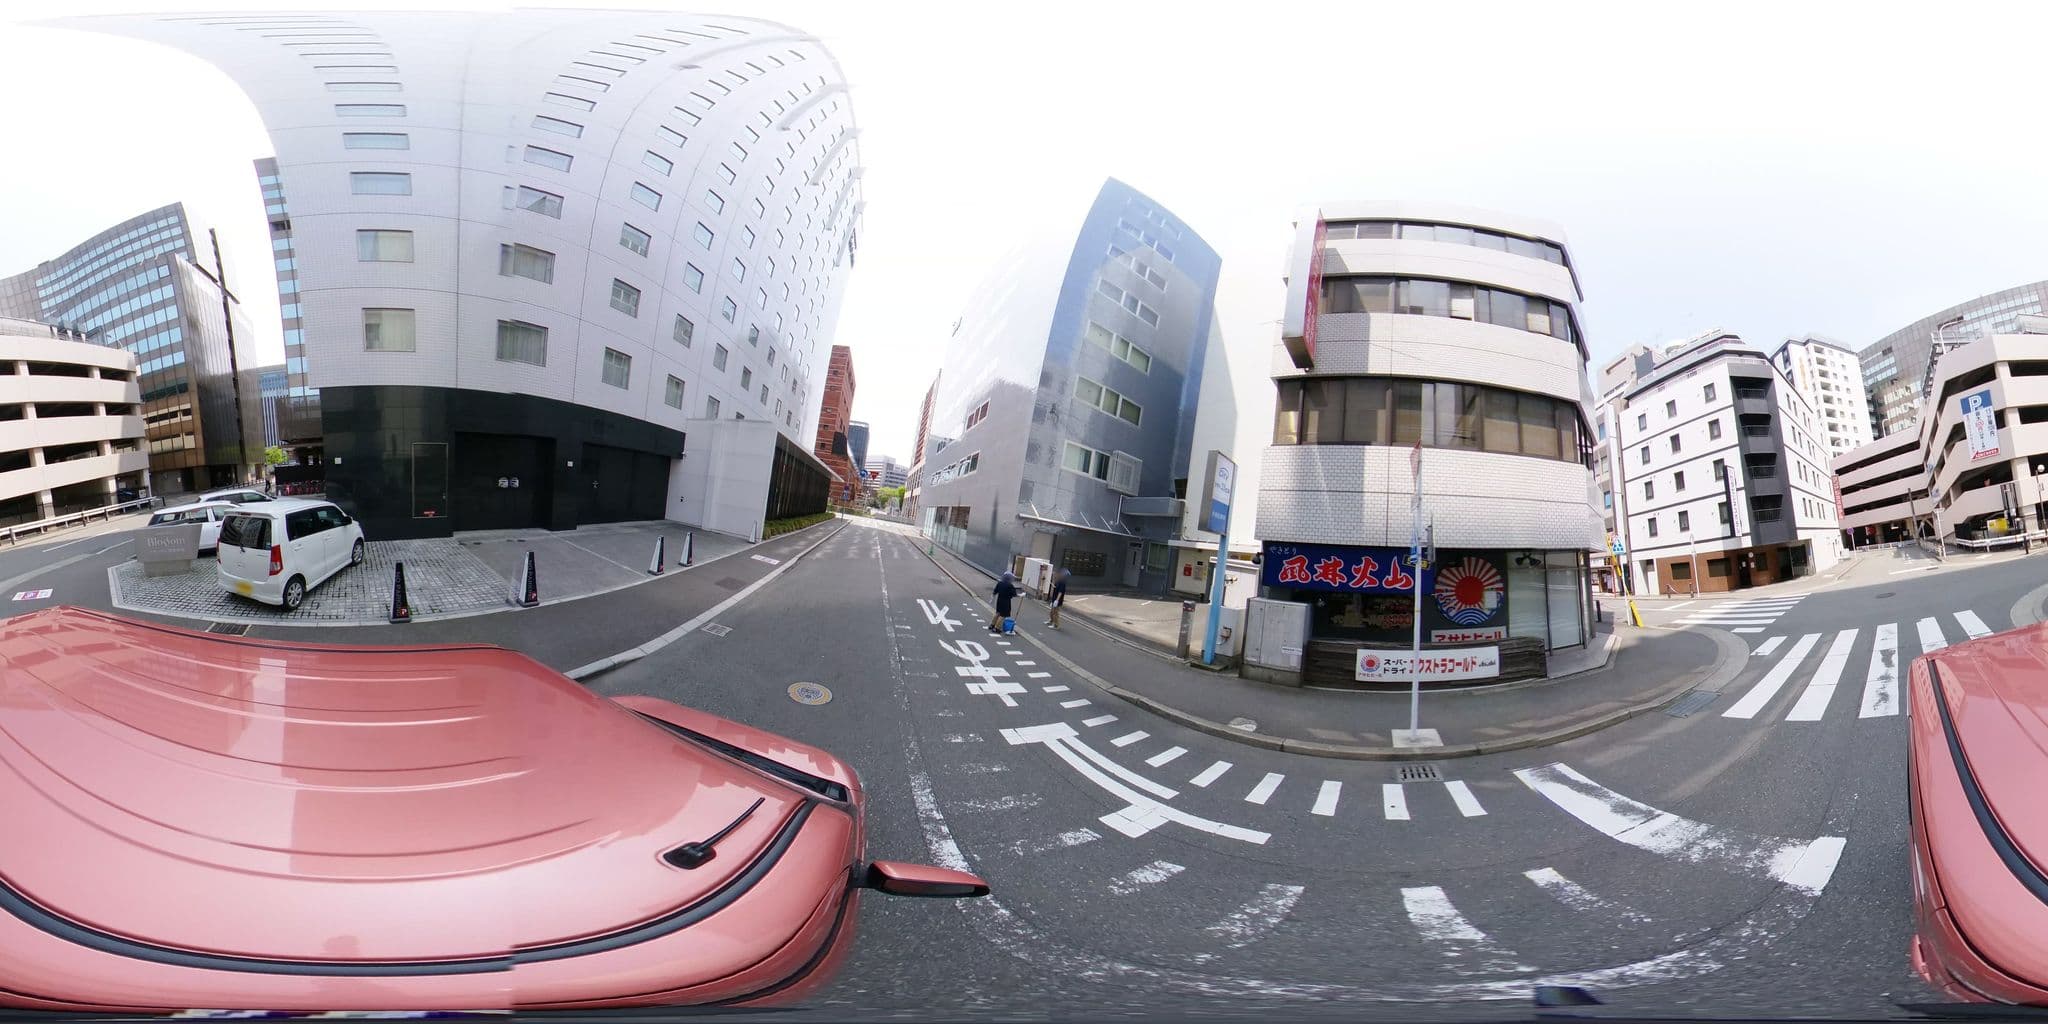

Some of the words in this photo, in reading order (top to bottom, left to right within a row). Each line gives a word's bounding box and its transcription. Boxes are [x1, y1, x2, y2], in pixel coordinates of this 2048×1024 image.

[1279, 554, 1414, 590] 風林火山
[1383, 658, 1408, 666] スーパー
[1383, 667, 1407, 675] ドライ
